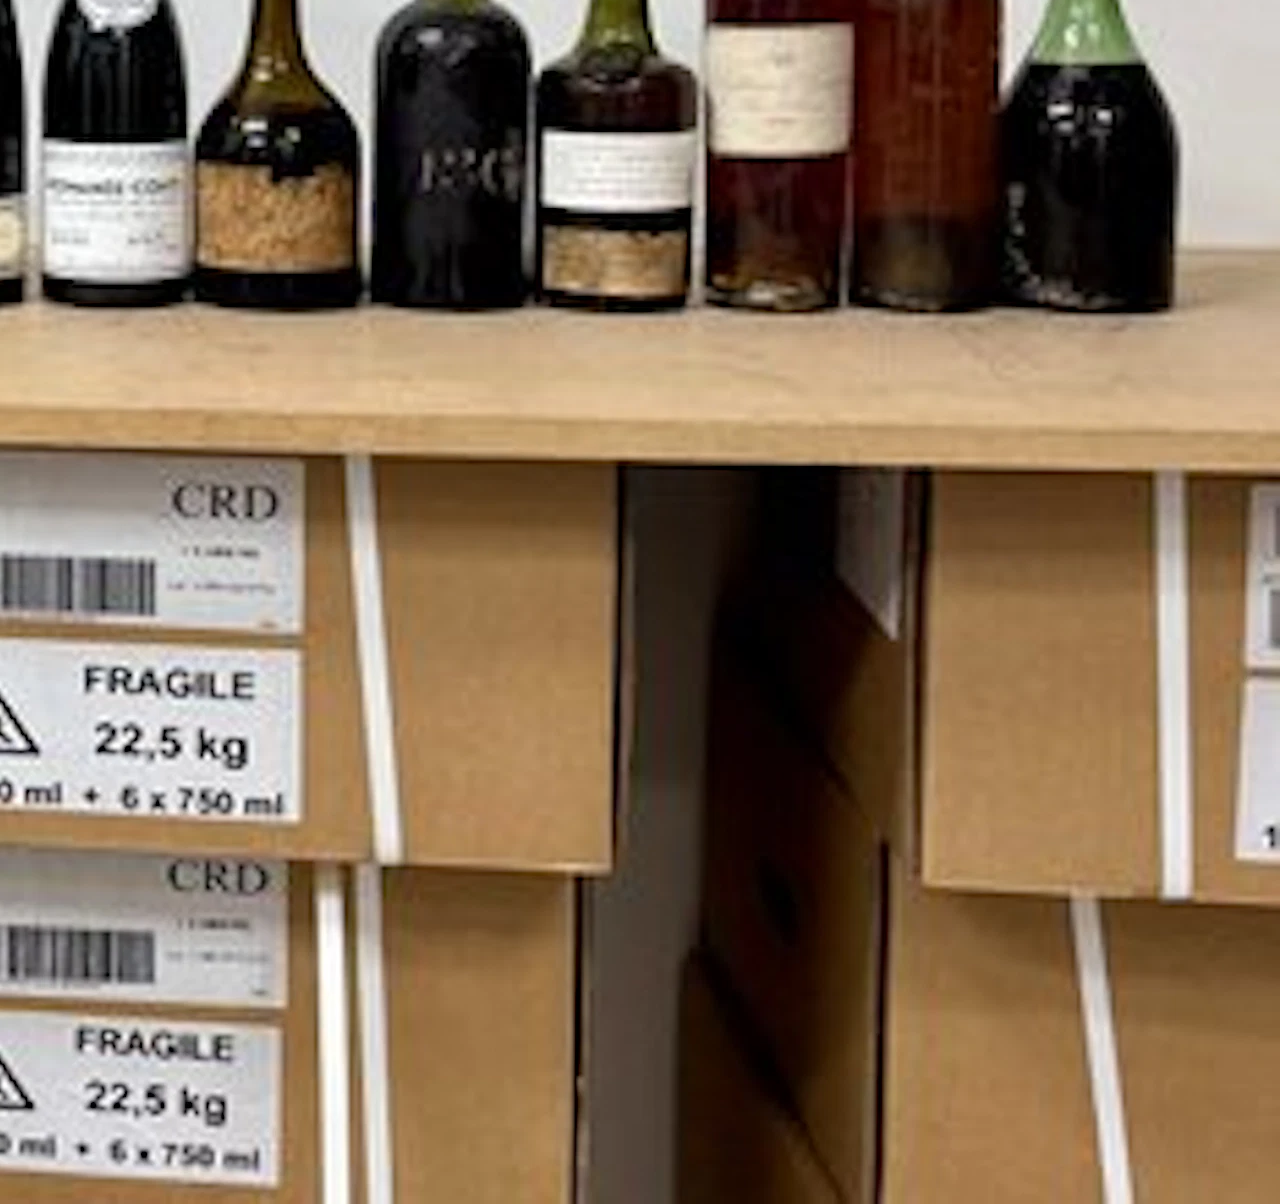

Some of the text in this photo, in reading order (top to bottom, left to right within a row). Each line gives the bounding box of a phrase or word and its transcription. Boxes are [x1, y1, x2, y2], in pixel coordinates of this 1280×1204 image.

[172, 484, 280, 519] CRD
[84, 666, 254, 700] FRAGILE
[95, 722, 248, 770] 22,5 kg
[24, 783, 62, 804] ml
[119, 786, 140, 811] 6
[150, 792, 167, 811] x
[179, 788, 234, 815] 750
[243, 793, 284, 816] ml
[167, 858, 270, 893] CRD
[76, 1028, 236, 1063] FRAGILE
[86, 1081, 227, 1127] 22,5 kg
[18, 1135, 57, 1159] ml
[108, 1138, 129, 1164] 6
[163, 1143, 215, 1168] 750
[222, 1148, 261, 1171] ml
